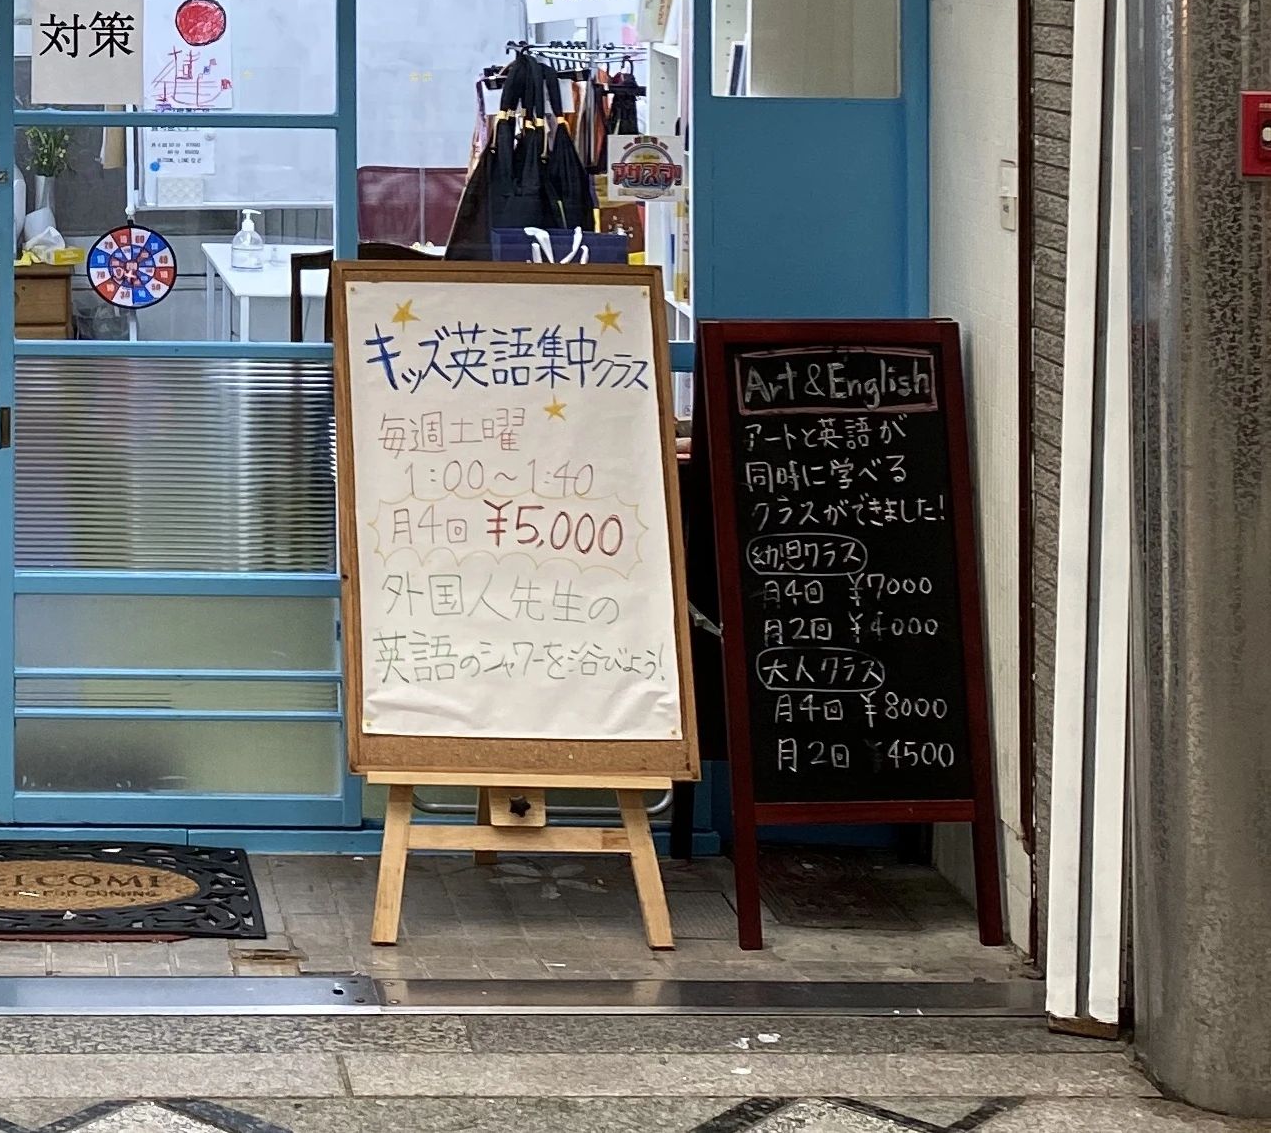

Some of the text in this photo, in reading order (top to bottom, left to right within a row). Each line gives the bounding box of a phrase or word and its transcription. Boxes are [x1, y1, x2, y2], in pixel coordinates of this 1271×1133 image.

[39, 11, 135, 58] 対策
[364, 322, 650, 393] キッズ英語集中クラス
[744, 366, 794, 404] Art
[828, 362, 932, 411] English
[379, 407, 525, 458] 毎週土曜
[743, 414, 907, 451] アートと英語が
[745, 456, 907, 493] 同時に学べる
[391, 500, 624, 556] 月4回 ¥5,000
[752, 494, 946, 532] クラスができました!
[382, 573, 621, 625] 外国人先生の
[762, 572, 933, 610] 月4回 ¥7000
[763, 611, 938, 647] 月2回 ¥4000
[373, 631, 666, 684] 英語のシャワーを浴びよう!
[762, 657, 882, 686] 大人クラス
[774, 691, 948, 727] 月4回 ¥8000
[777, 738, 850, 772] 月2回
